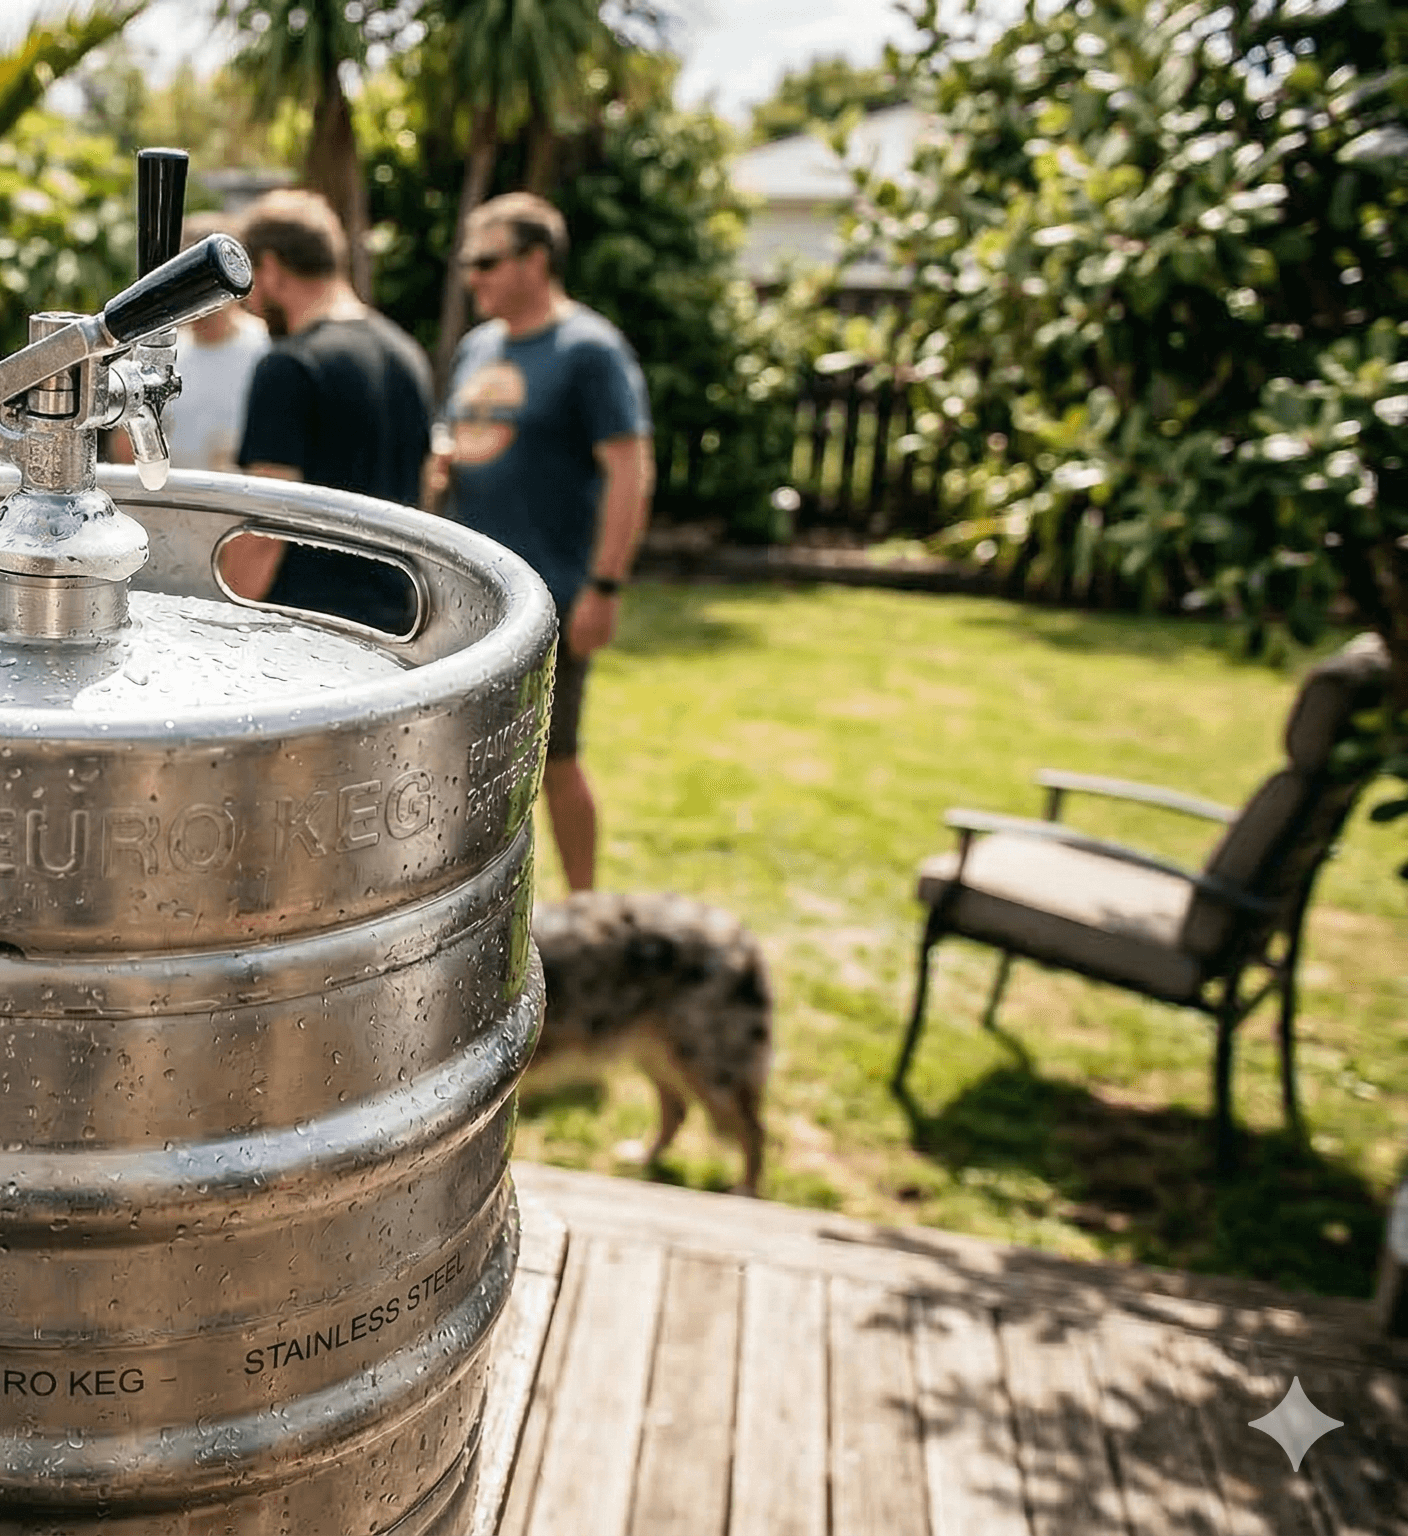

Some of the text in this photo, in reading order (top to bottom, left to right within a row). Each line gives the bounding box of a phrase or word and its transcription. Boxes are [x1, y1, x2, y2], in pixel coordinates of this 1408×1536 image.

[273, 768, 434, 860] KEG
[69, 1367, 145, 1396] KEG
[244, 1298, 400, 1375] STAINLESS
[406, 1251, 465, 1311] STEEL
